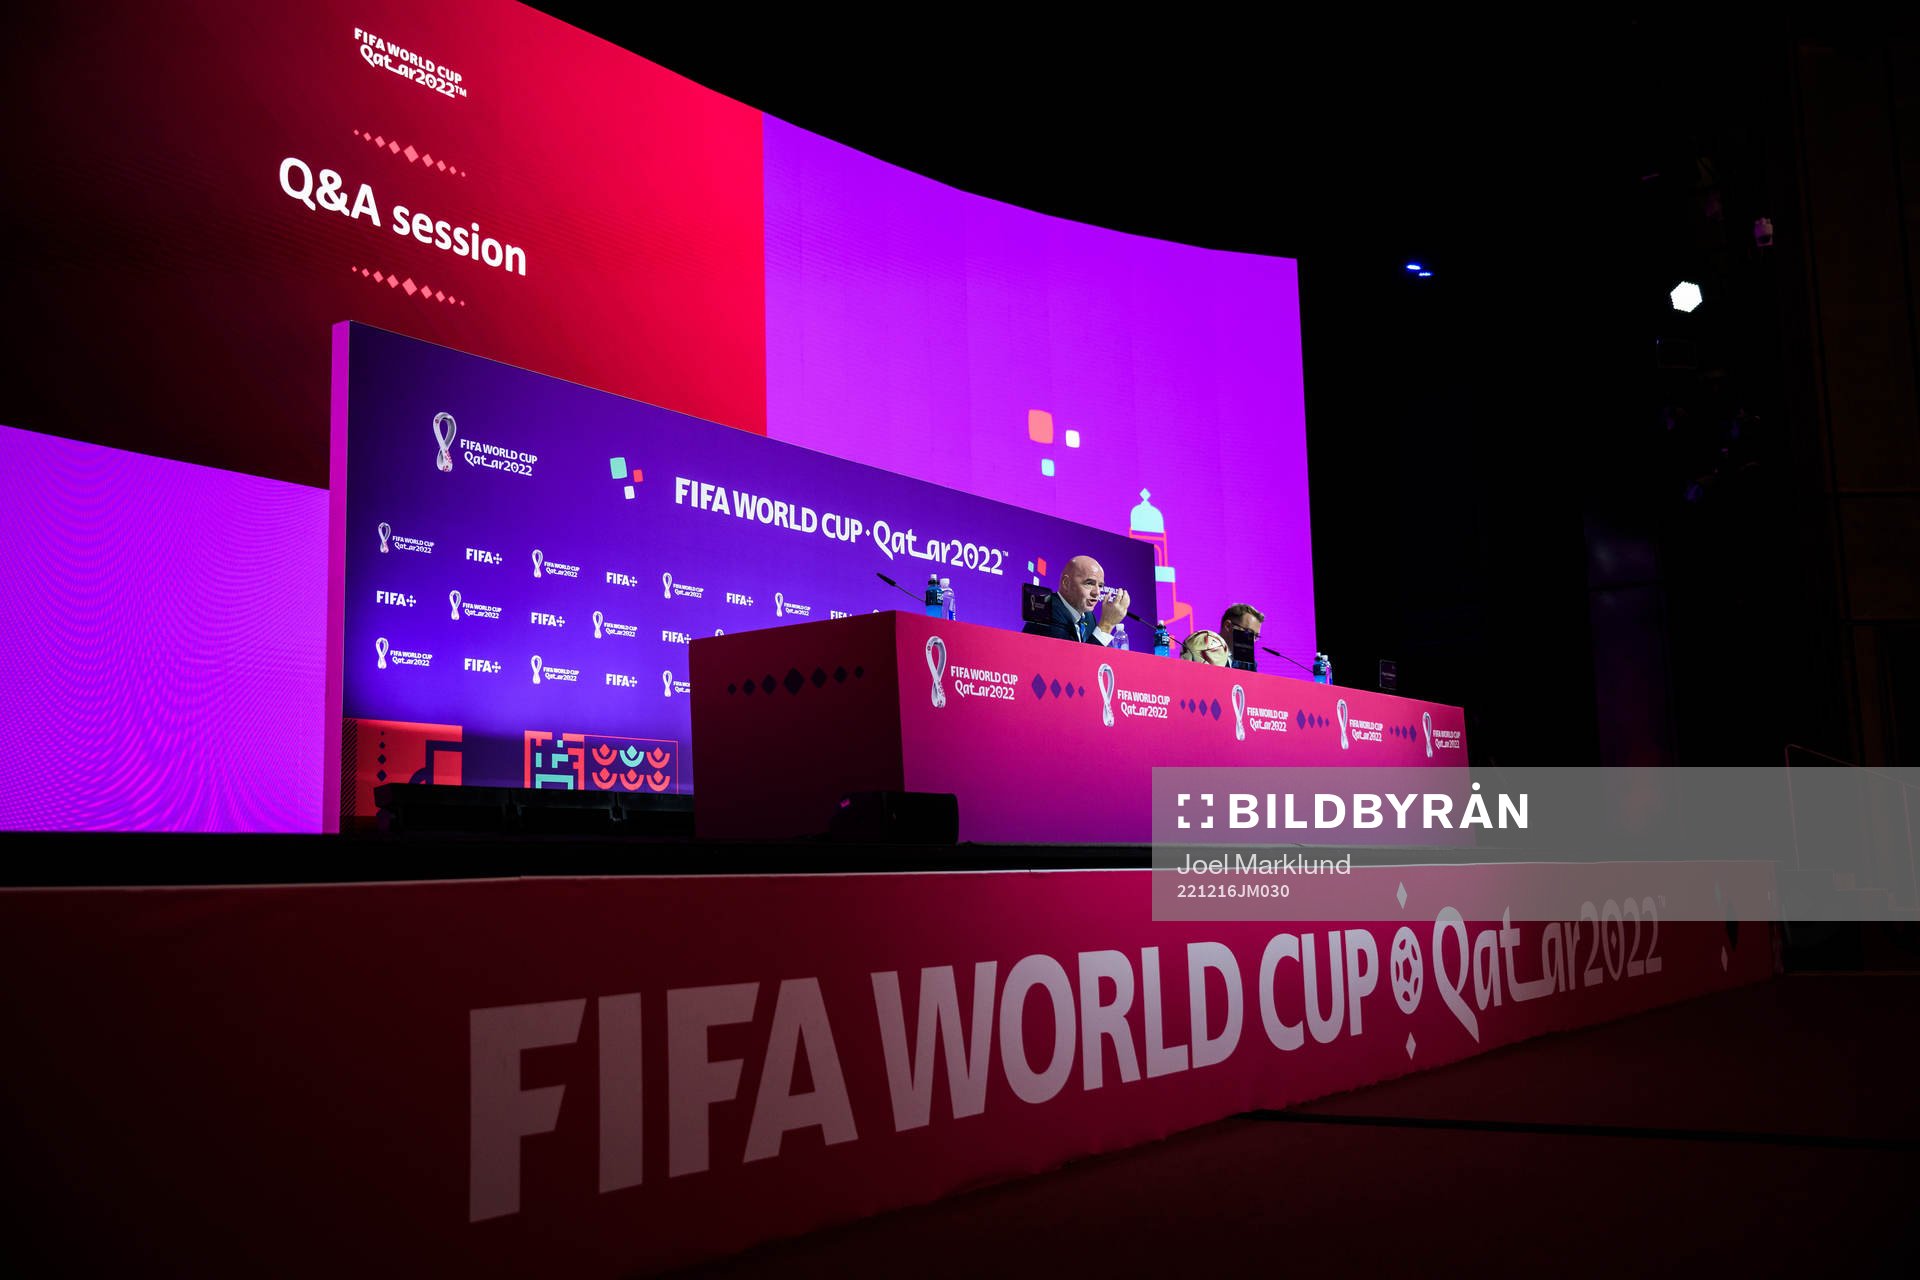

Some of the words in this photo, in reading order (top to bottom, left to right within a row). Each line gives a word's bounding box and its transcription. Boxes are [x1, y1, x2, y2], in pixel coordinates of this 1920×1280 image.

[354, 27, 385, 51] FIFA
[386, 41, 435, 73] WORLD
[437, 65, 463, 85] CUP
[279, 157, 382, 228] Q&A
[392, 205, 527, 276] session
[460, 439, 482, 453] FIFA
[483, 444, 518, 460] WORLD
[519, 452, 538, 464] CUP
[675, 476, 730, 516] FIFA
[732, 490, 818, 534] WORLD
[821, 512, 863, 543] CUP
[392, 535, 404, 543] FIFA
[404, 537, 424, 546] WORLD
[951, 666, 970, 679] FIFA
[970, 669, 1001, 683] WORLD
[1002, 673, 1018, 685] CUP
[1117, 689, 1132, 701] FIFA
[1133, 691, 1157, 704] WORLD
[1158, 695, 1171, 705] CUP
[1247, 707, 1259, 717] FIFA
[1259, 708, 1278, 719] WORLD
[1278, 711, 1289, 720] CUP
[470, 976, 859, 1223] FIFA
[870, 940, 1244, 1133] WORLD
[1258, 928, 1379, 1052] CUP
